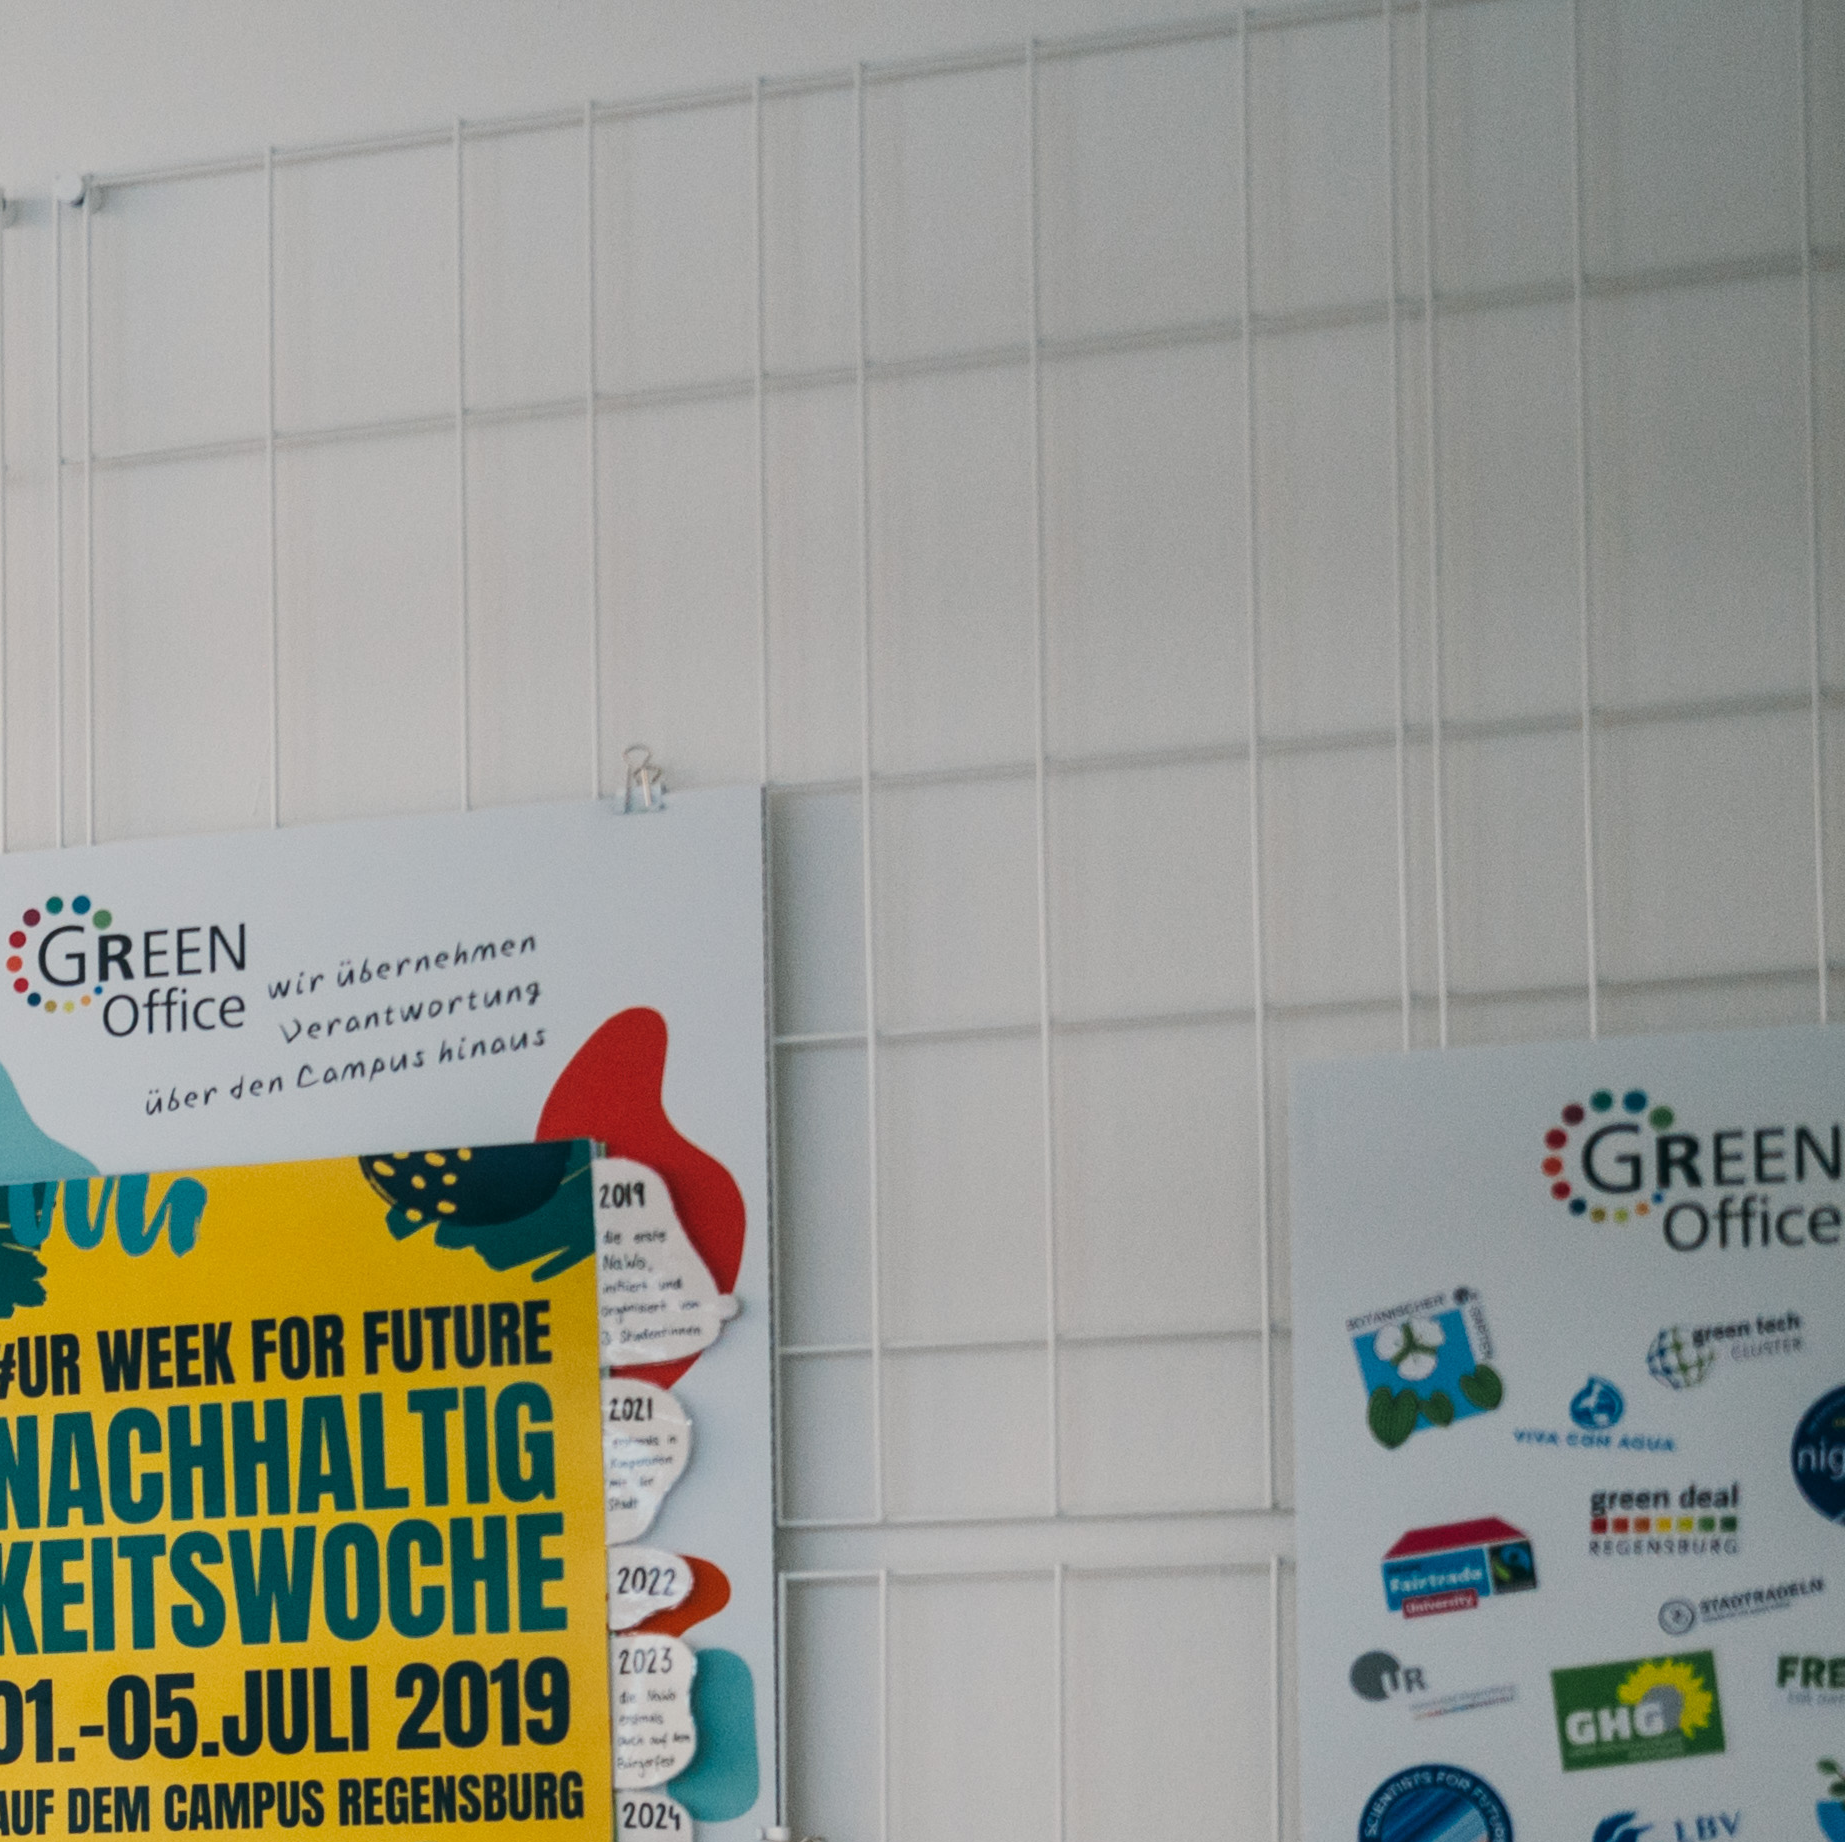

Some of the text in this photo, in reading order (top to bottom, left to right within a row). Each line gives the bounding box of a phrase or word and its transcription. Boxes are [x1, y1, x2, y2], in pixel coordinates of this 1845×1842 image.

[37, 923, 247, 988] GREEN
[267, 932, 538, 1002] wir übernehmen
[101, 985, 246, 1038] Office
[278, 979, 543, 1046] Verantwortung
[144, 1026, 548, 1118] über den Campus hinaus
[1581, 1121, 1844, 1195] GREEN
[599, 1181, 646, 1209] 2019
[1662, 1194, 1843, 1253] Office
[96, 1321, 236, 1394] WEEK
[250, 1313, 346, 1385] FOR
[361, 1299, 554, 1375] FUTURE
[1691, 1319, 1750, 1347] green
[609, 1397, 653, 1421] 2021
[1512, 1428, 1676, 1454] VIVA CON AGUA
[1590, 1481, 1740, 1519] green deal
[1588, 1538, 1740, 1557] REGENSBURG
[616, 1565, 677, 1597] 2022
[618, 1647, 673, 1675] 2023
[395, 1655, 572, 1752] 2019
[1565, 1701, 1666, 1746] GHG
[67, 1784, 151, 1834] DEM
[163, 1778, 327, 1833] CAMPUS
[338, 1770, 586, 1827] REGENSBURG
[1436, 1772, 1471, 1791] FOR
[622, 1801, 682, 1831] 2024
